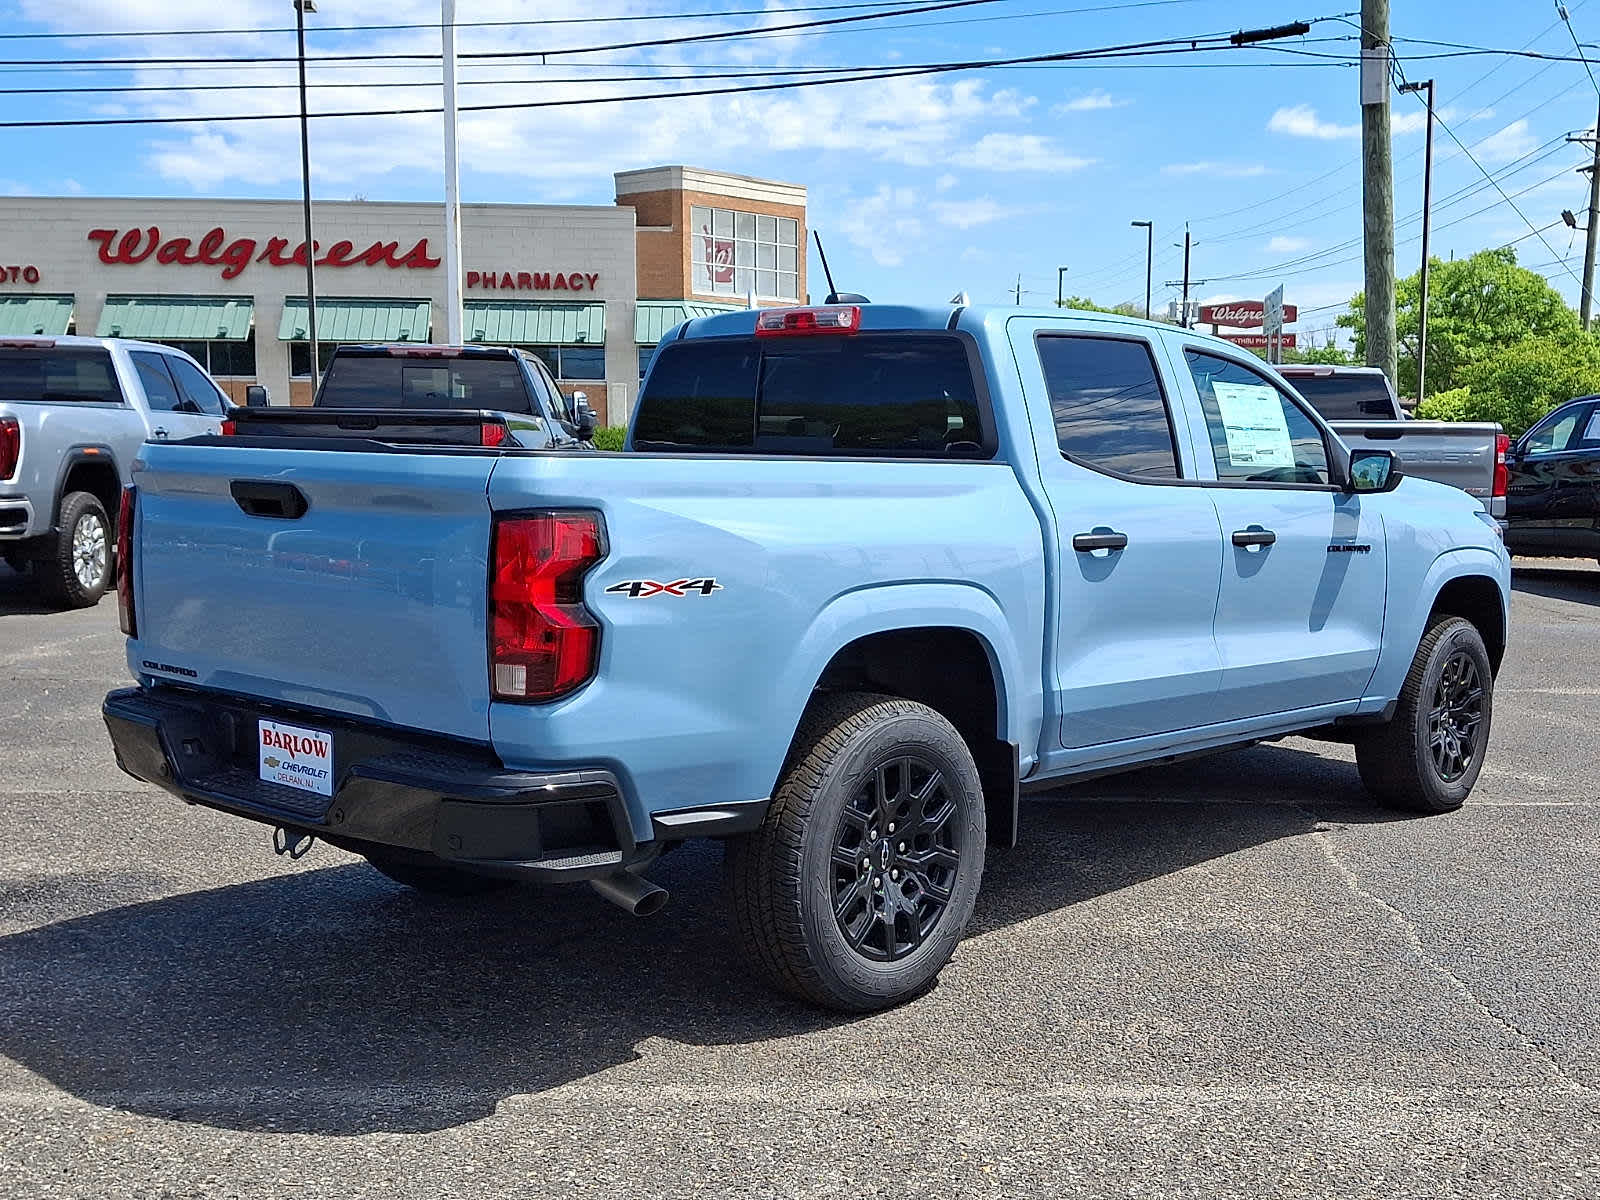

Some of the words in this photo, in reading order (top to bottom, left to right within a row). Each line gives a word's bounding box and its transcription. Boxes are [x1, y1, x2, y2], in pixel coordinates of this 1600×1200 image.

[87, 226, 442, 280] Walgreens
[466, 271, 599, 291] PHARMACY
[1211, 306, 1288, 324] Walgre
[1255, 337, 1291, 345] PHAMCY
[1326, 544, 1371, 554] COLORADO
[142, 660, 198, 678] COLORADO
[262, 729, 328, 760] BARLOW
[281, 761, 329, 780] CHEVROLET
[305, 779, 314, 788] NJ
